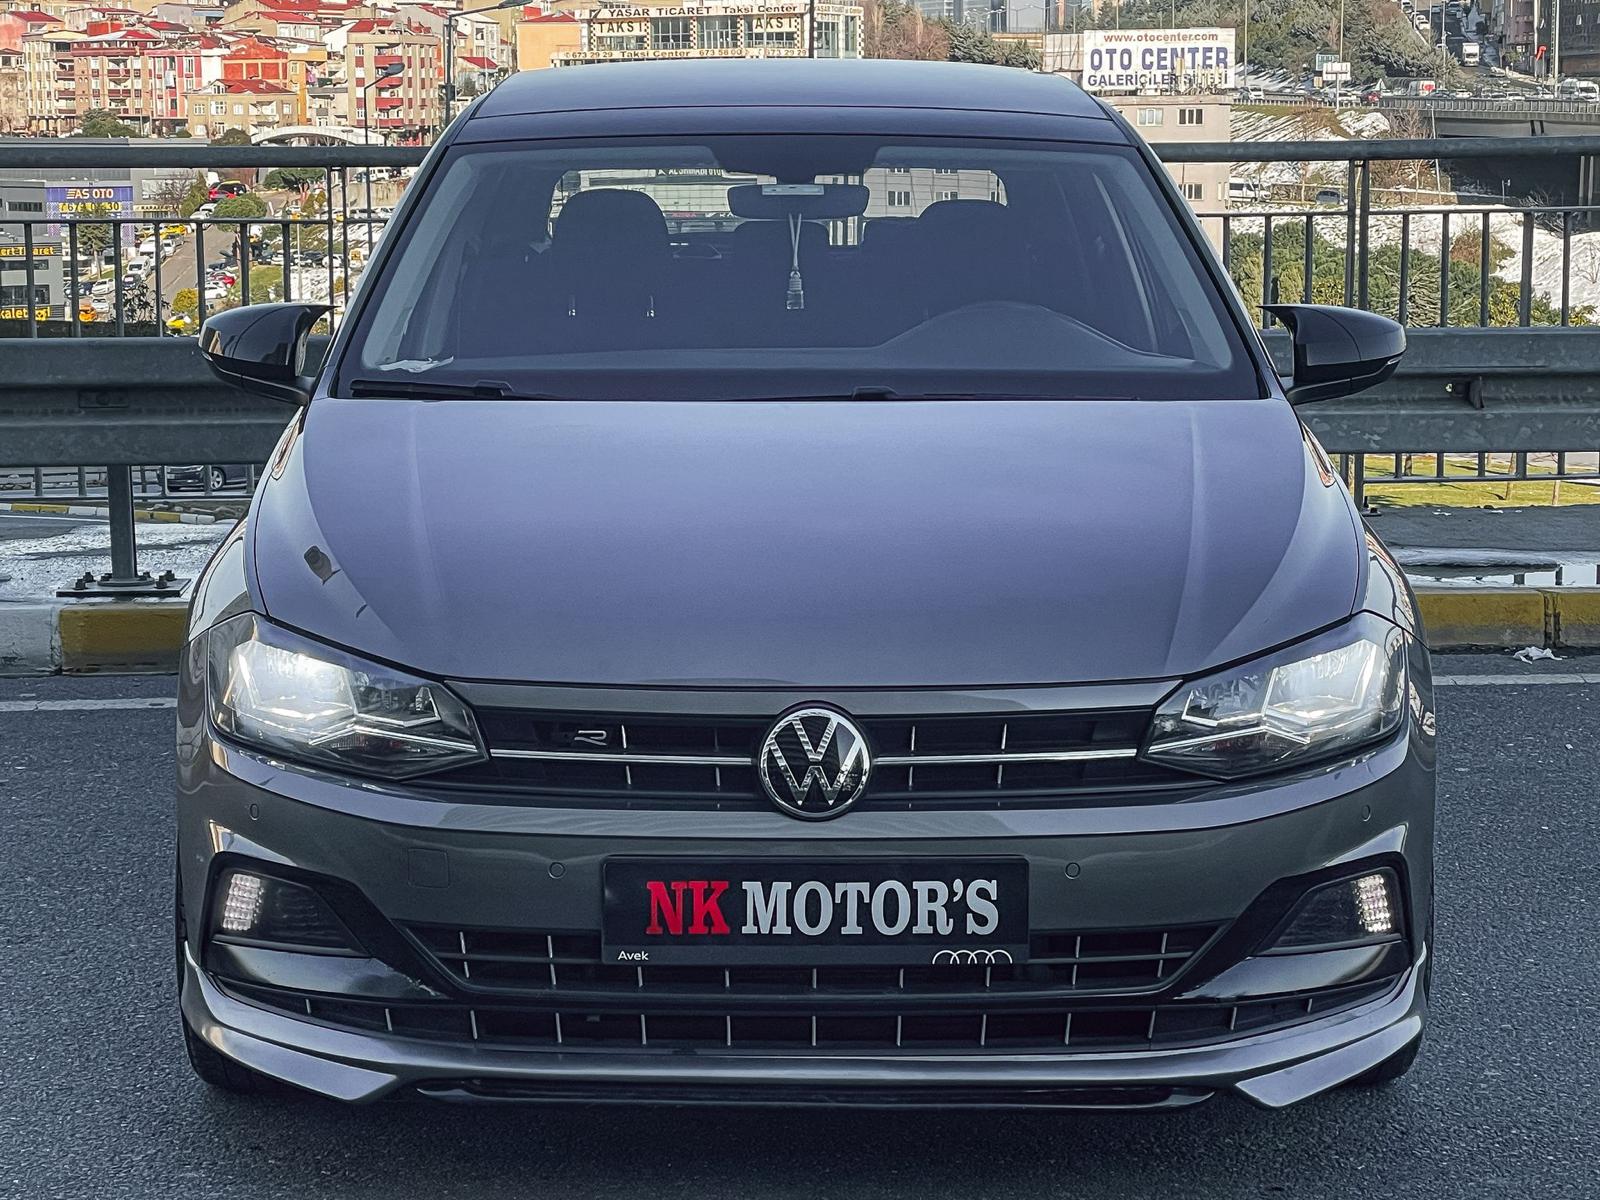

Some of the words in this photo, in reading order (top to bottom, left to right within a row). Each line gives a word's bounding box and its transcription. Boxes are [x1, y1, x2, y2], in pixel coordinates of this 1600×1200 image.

[722, 5, 754, 14] Taksi
[758, 4, 798, 13] Center
[1104, 32, 1219, 42] www.otocenter.com
[1090, 48, 1132, 71] OTO
[1141, 47, 1228, 70] CENTER
[92, 188, 114, 199] OTO
[645, 880, 731, 936] NK
[741, 878, 1000, 936] MOTOR'S
[617, 950, 649, 961] Avek
